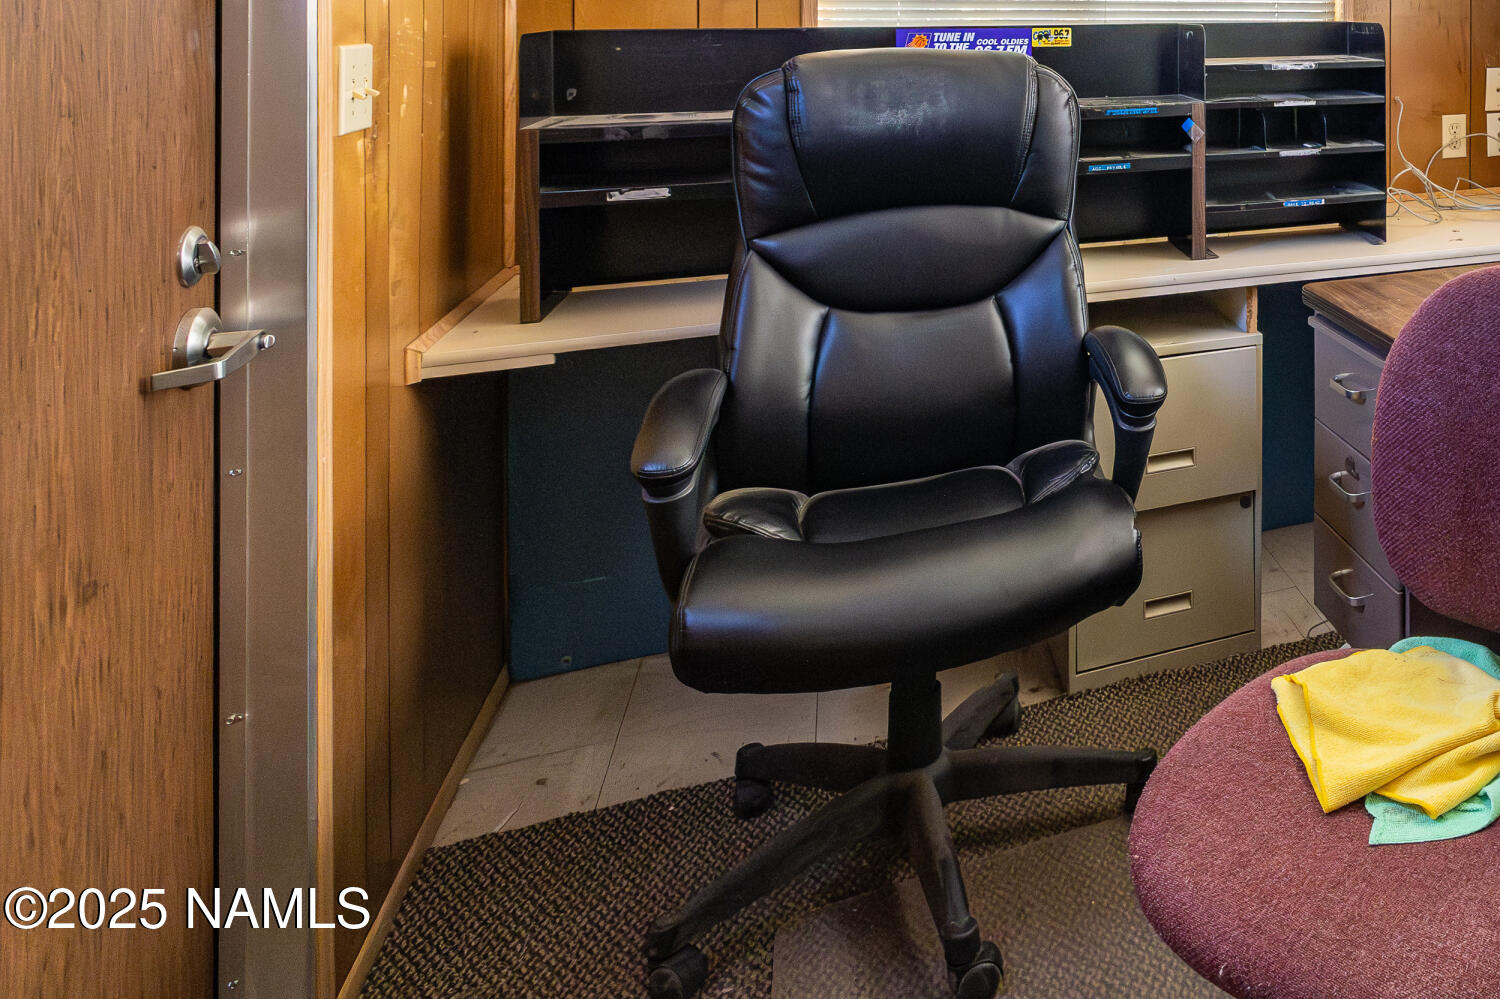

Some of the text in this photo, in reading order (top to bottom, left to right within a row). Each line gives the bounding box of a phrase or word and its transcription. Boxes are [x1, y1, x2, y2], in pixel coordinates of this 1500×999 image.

[933, 32, 976, 42] TUNE IN
[934, 42, 948, 50] TO
[950, 42, 970, 50] THE
